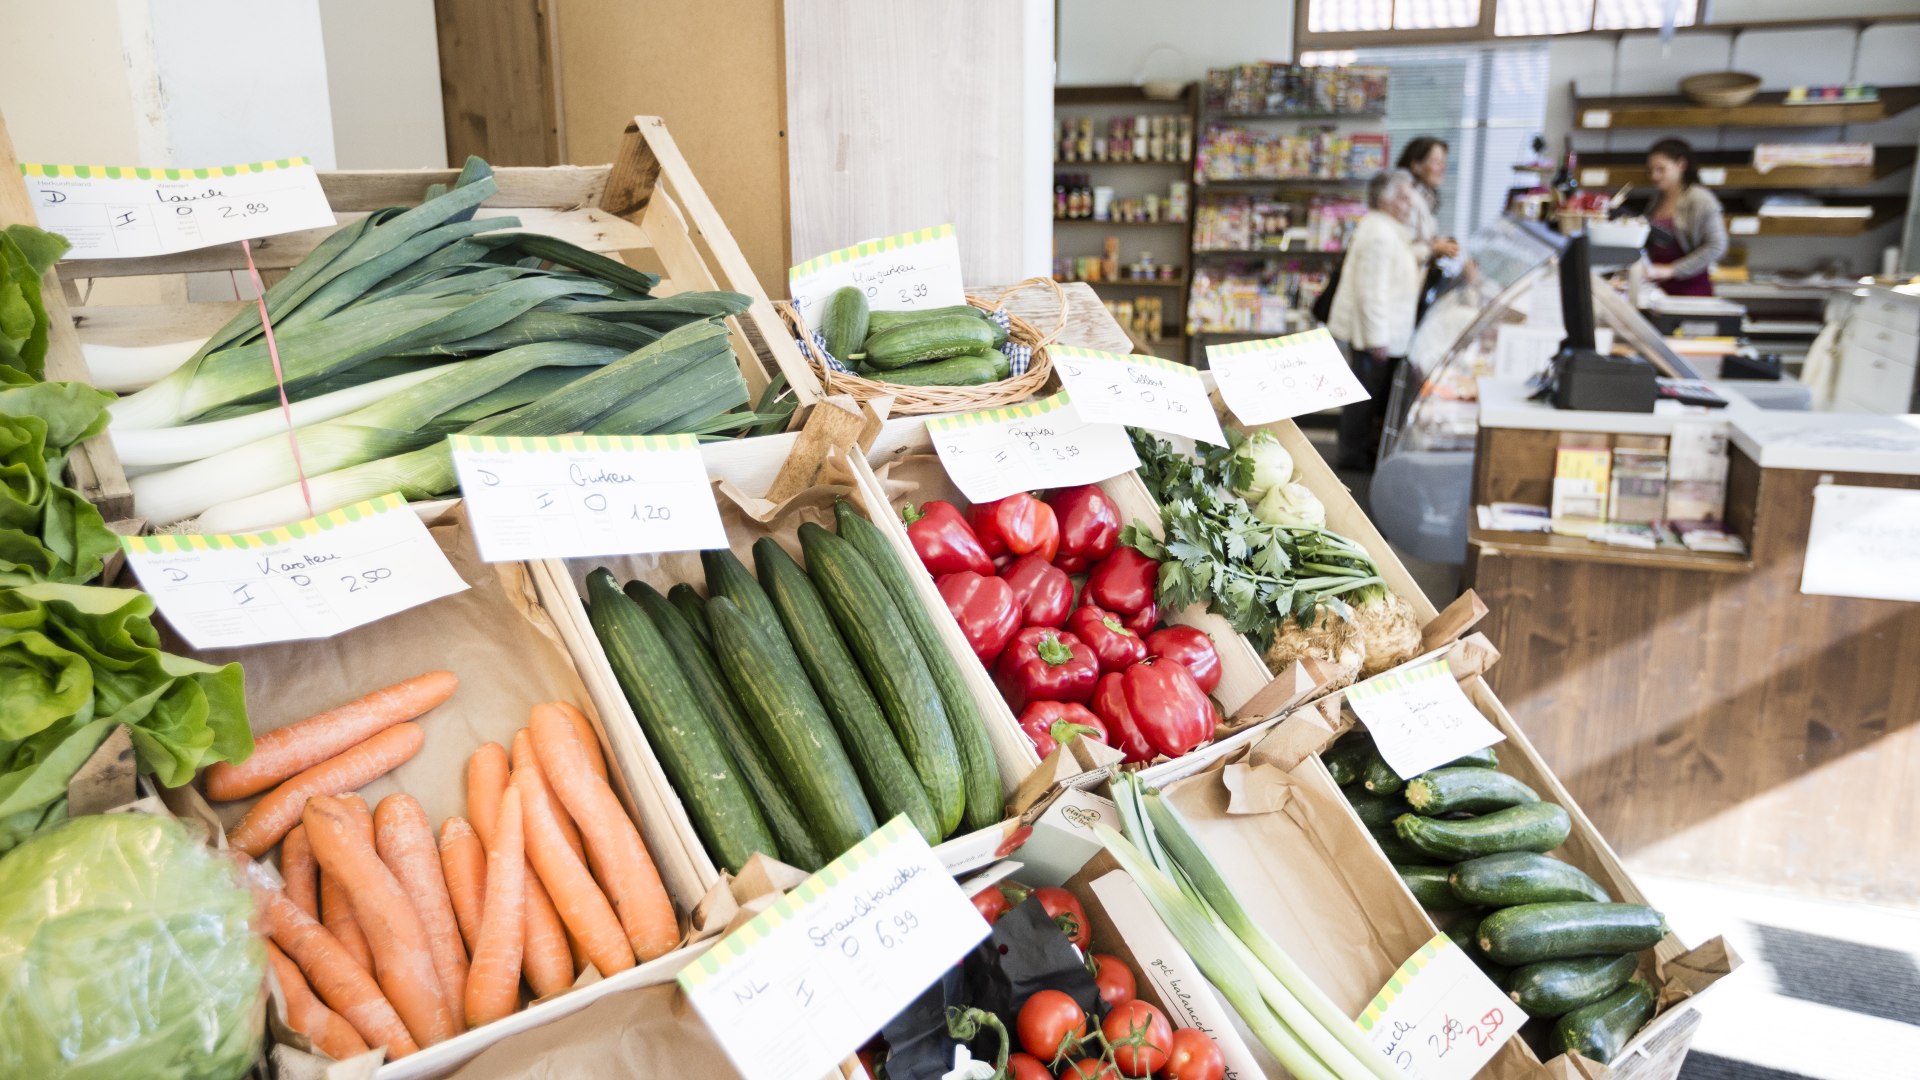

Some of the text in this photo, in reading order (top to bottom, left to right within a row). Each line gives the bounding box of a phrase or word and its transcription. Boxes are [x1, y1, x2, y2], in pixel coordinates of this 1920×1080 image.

[40, 190, 66, 203] D
[156, 189, 224, 203] Lauch
[218, 202, 269, 219] 2,99
[477, 469, 501, 486] D
[569, 463, 636, 487] Gurken
[631, 503, 671, 523] 1,20
[163, 568, 189, 582] D
[256, 554, 342, 576] Karotten
[341, 567, 392, 593] 2,50
[875, 909, 919, 949] 6,99
[733, 981, 770, 1005] NL
[1150, 957, 1174, 977] get
[1170, 978, 1214, 1034] balanced
[1467, 1008, 1504, 1047] 2,50
